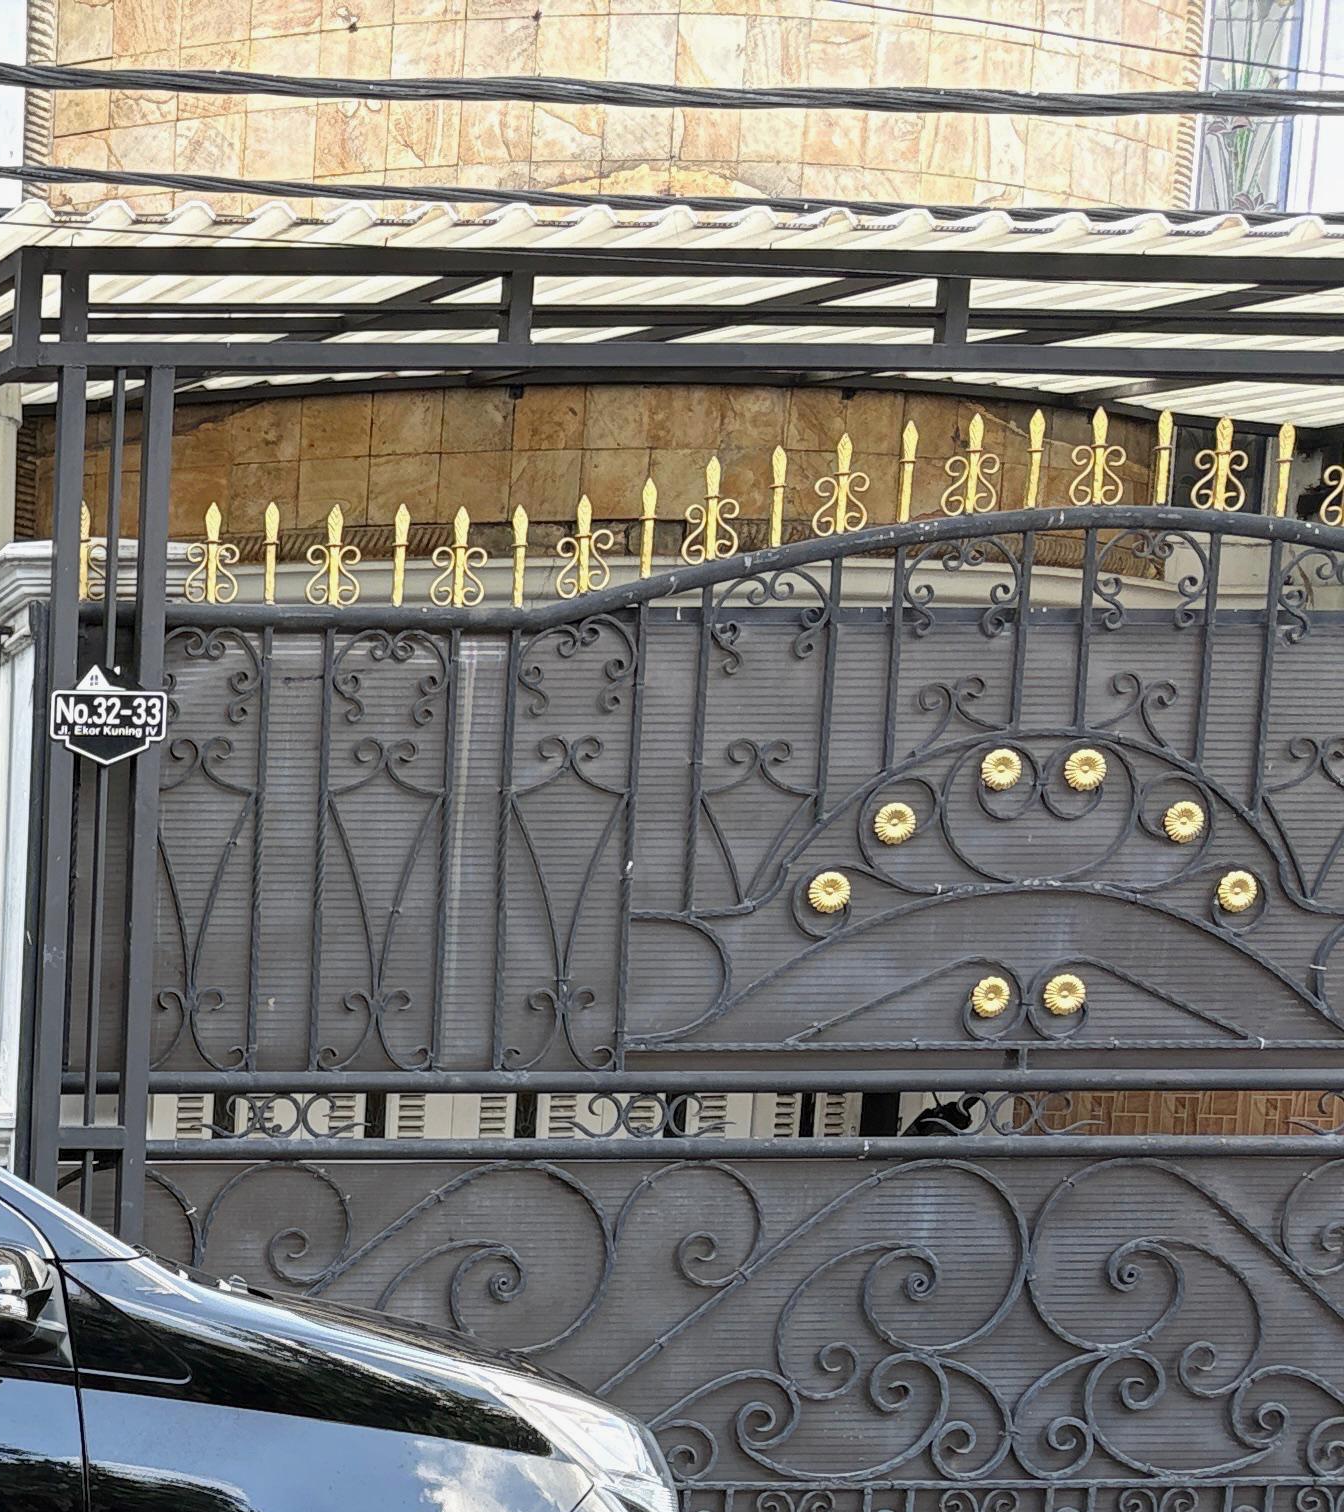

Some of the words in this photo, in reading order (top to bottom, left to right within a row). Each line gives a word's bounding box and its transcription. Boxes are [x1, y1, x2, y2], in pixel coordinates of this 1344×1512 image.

[55, 696, 161, 725] No.32-33
[57, 726, 70, 736] Jl.
[74, 725, 100, 736] Ekor
[103, 725, 142, 738] Kuning
[145, 725, 158, 736] IV
